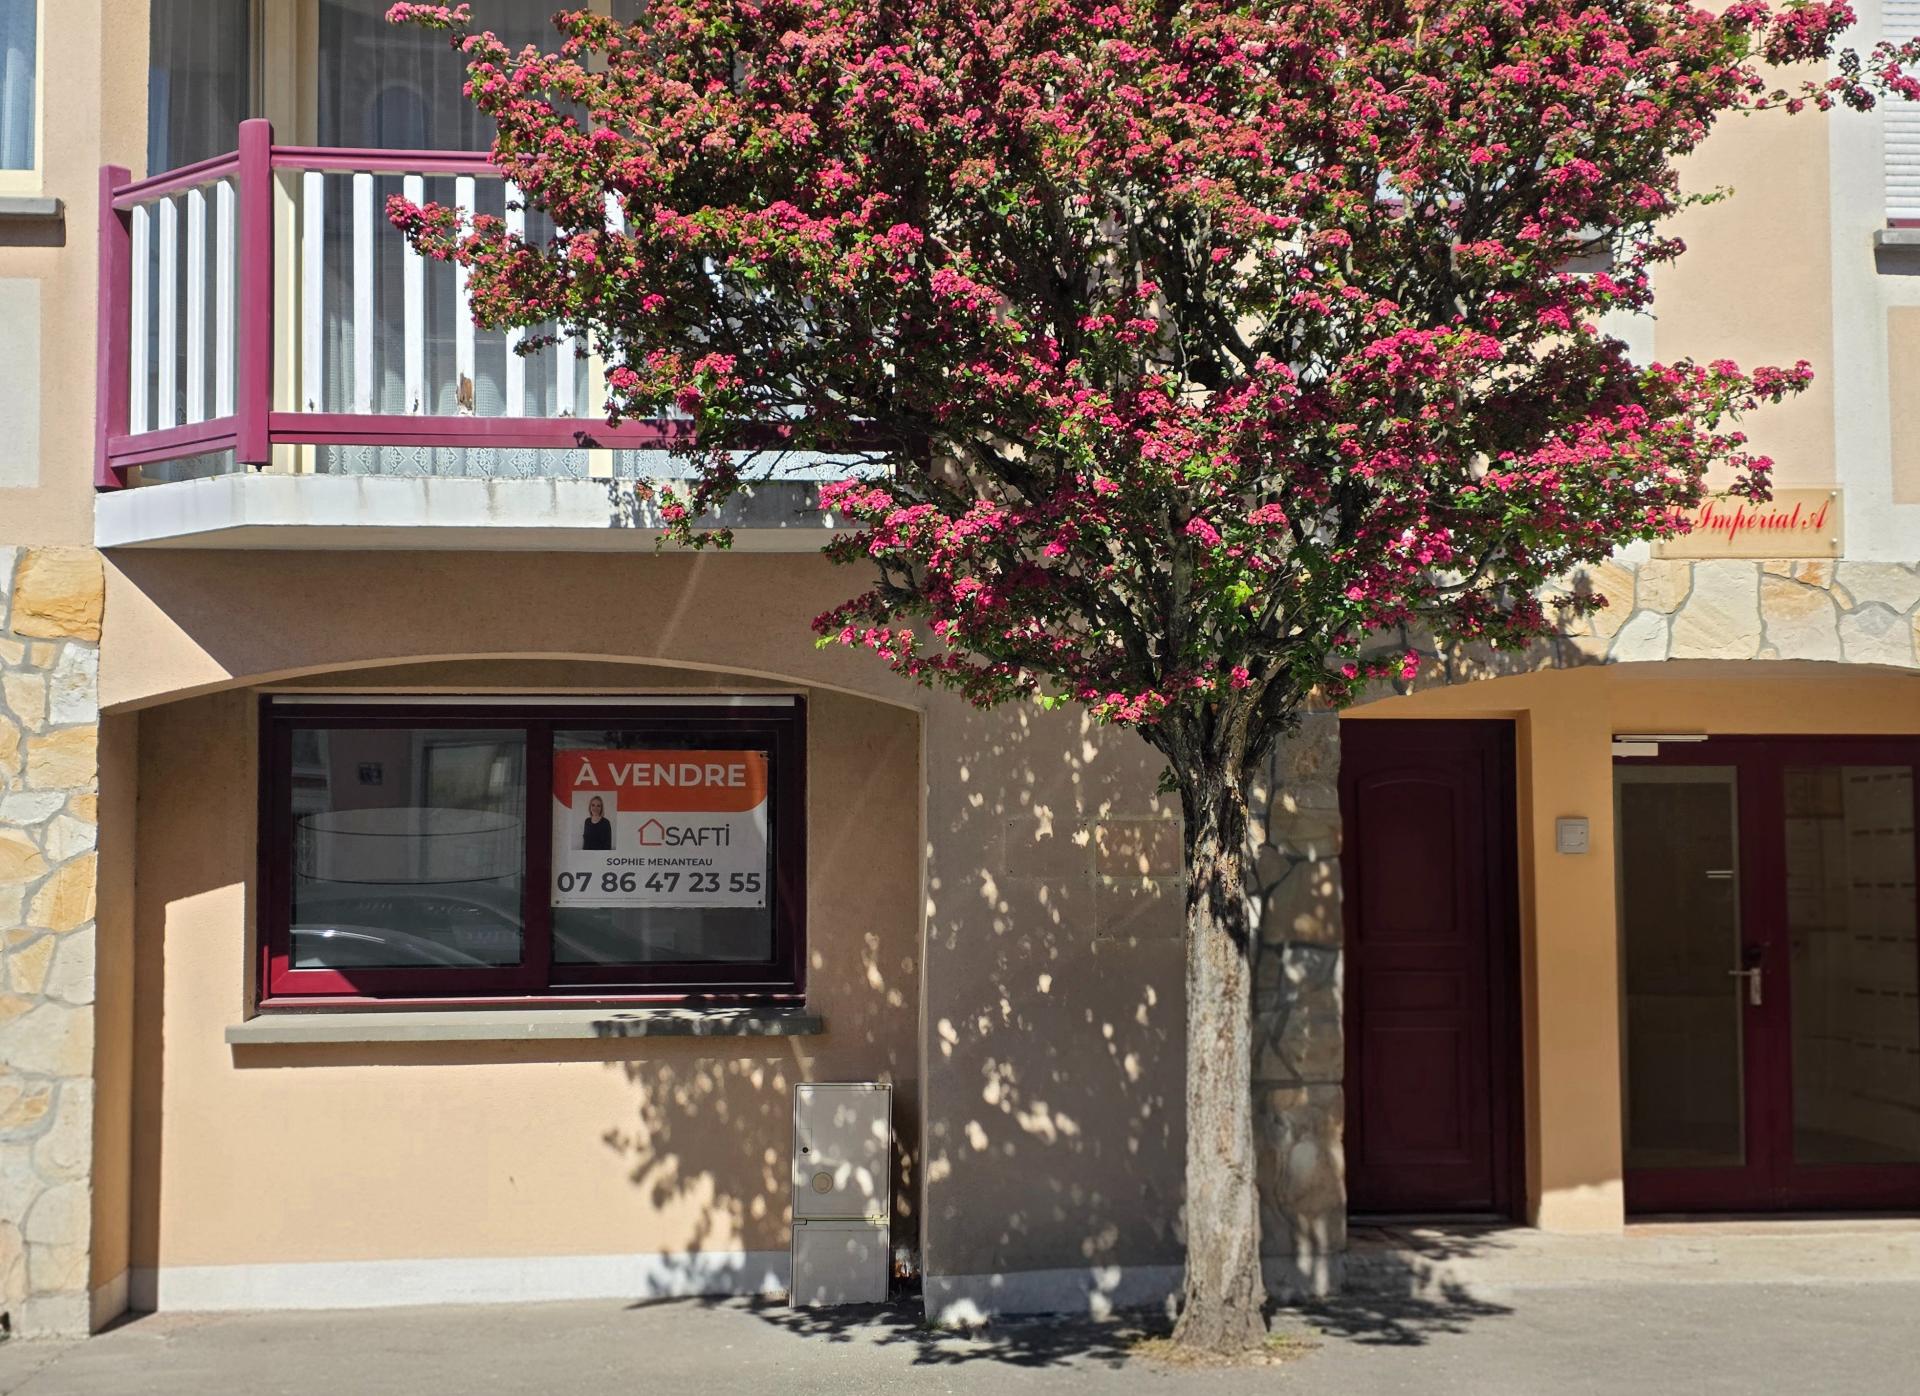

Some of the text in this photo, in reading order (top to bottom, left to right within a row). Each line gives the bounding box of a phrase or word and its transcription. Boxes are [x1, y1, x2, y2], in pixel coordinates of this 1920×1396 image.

[1693, 500, 1802, 542] Impérial
[1802, 499, 1830, 529] A
[574, 756, 747, 788] À VENDRE
[606, 857, 713, 867] SOPHIE MENANTEAU
[557, 871, 761, 893] 07 86 47 23 55
